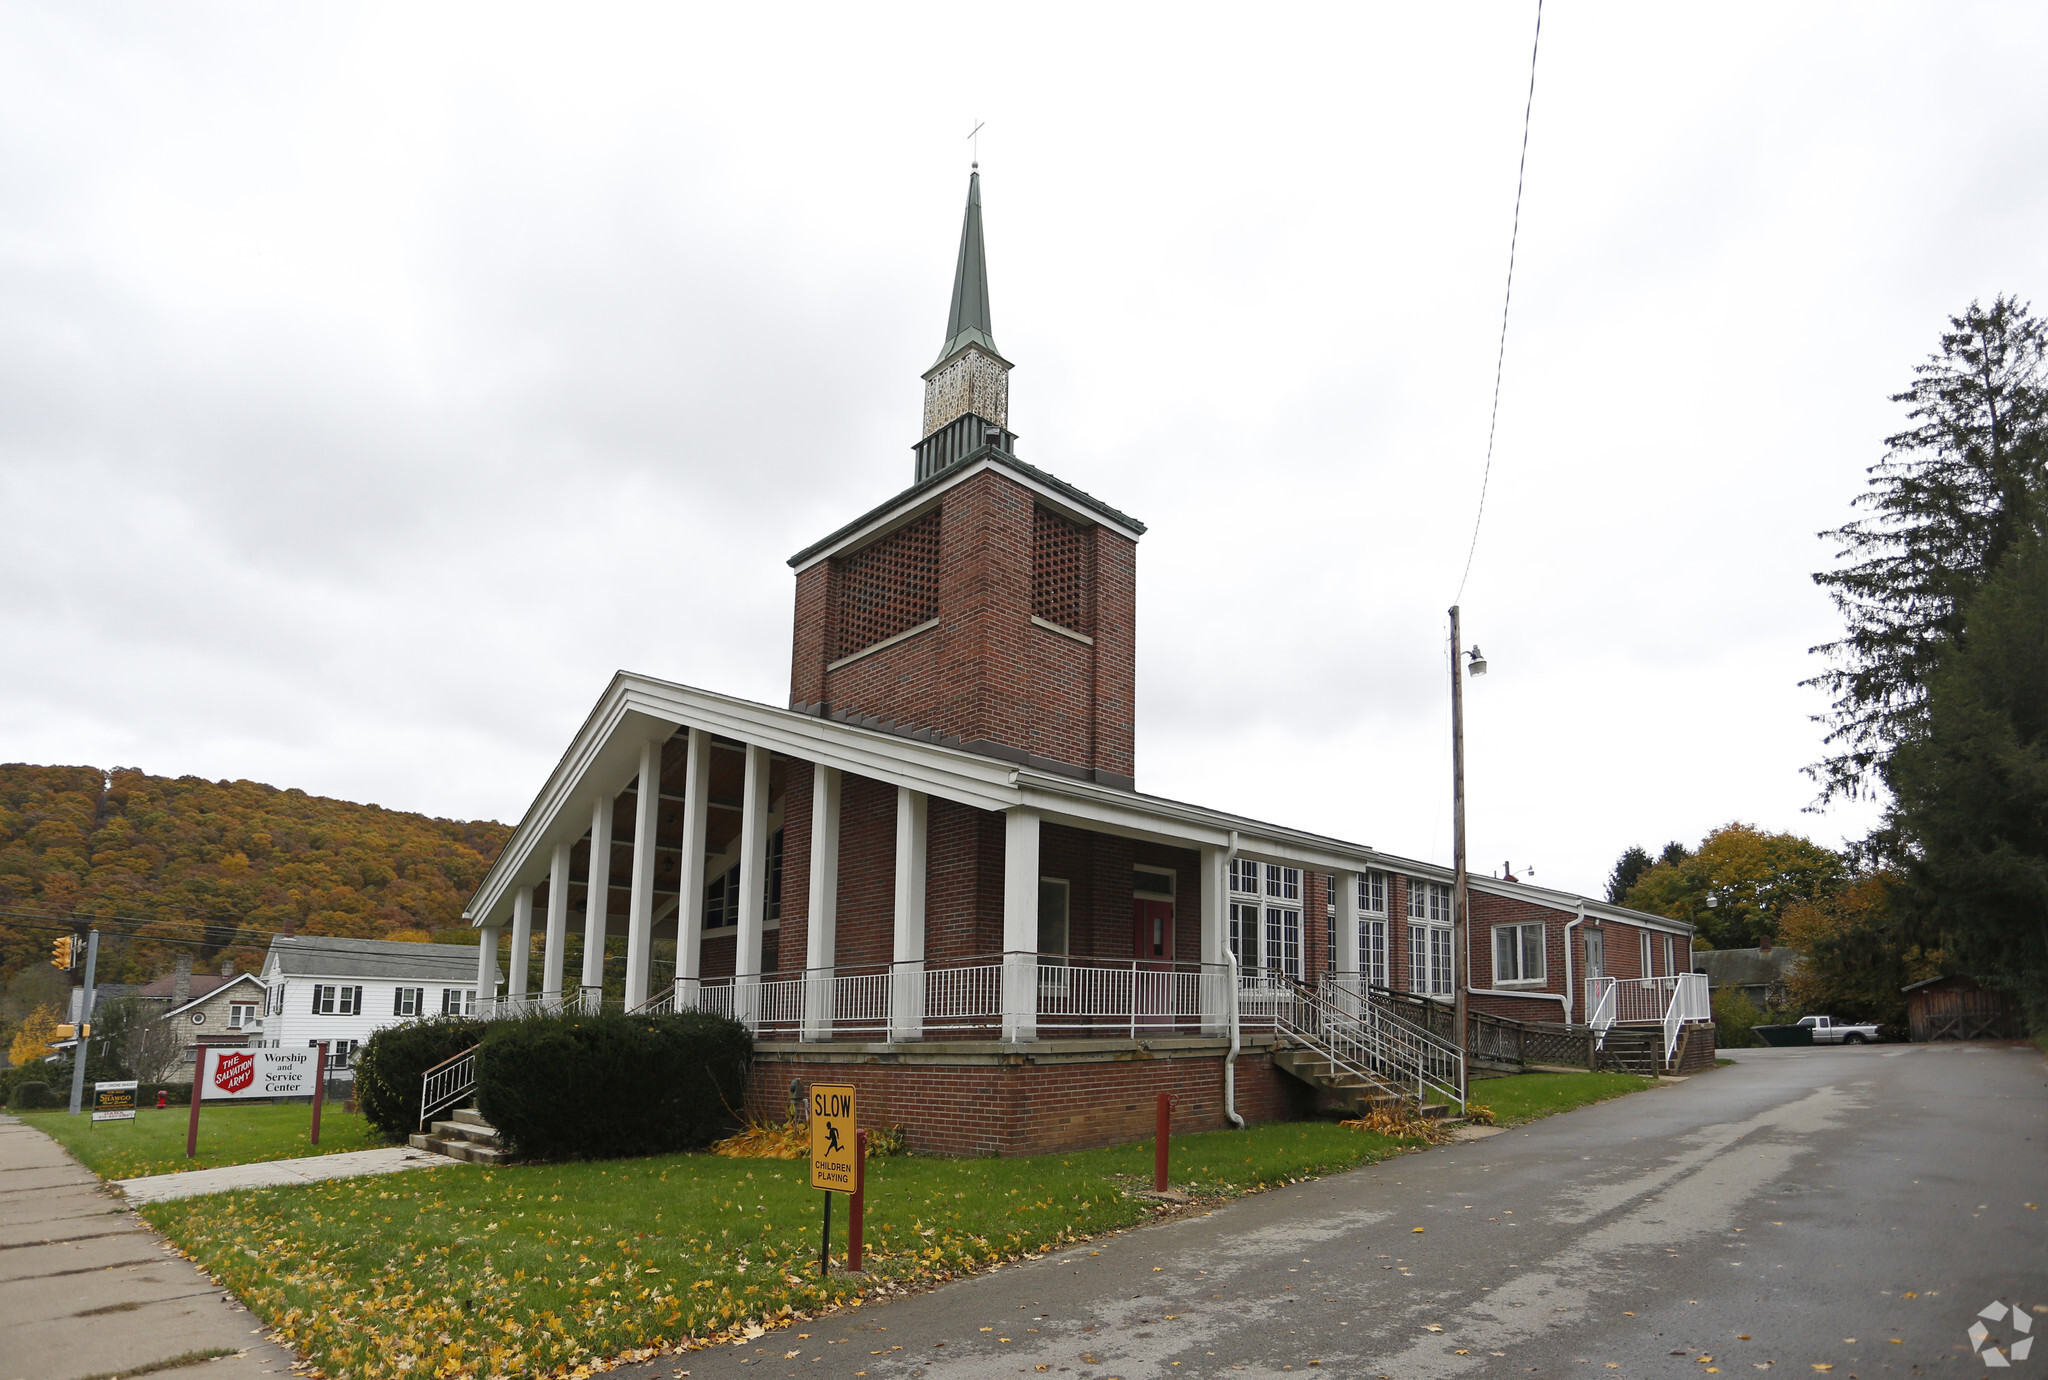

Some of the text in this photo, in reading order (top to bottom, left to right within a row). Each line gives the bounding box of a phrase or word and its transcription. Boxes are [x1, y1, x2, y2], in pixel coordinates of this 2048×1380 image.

[222, 1055, 239, 1070] THE
[265, 1053, 307, 1064] Worship
[215, 1058, 253, 1084] SALVATION
[265, 1072, 302, 1082] Service
[228, 1070, 251, 1088] ARMY
[265, 1082, 300, 1092] Center
[815, 1093, 851, 1118] SLOW
[816, 1161, 851, 1172] CHILDREN
[818, 1171, 848, 1183] PLAYING
